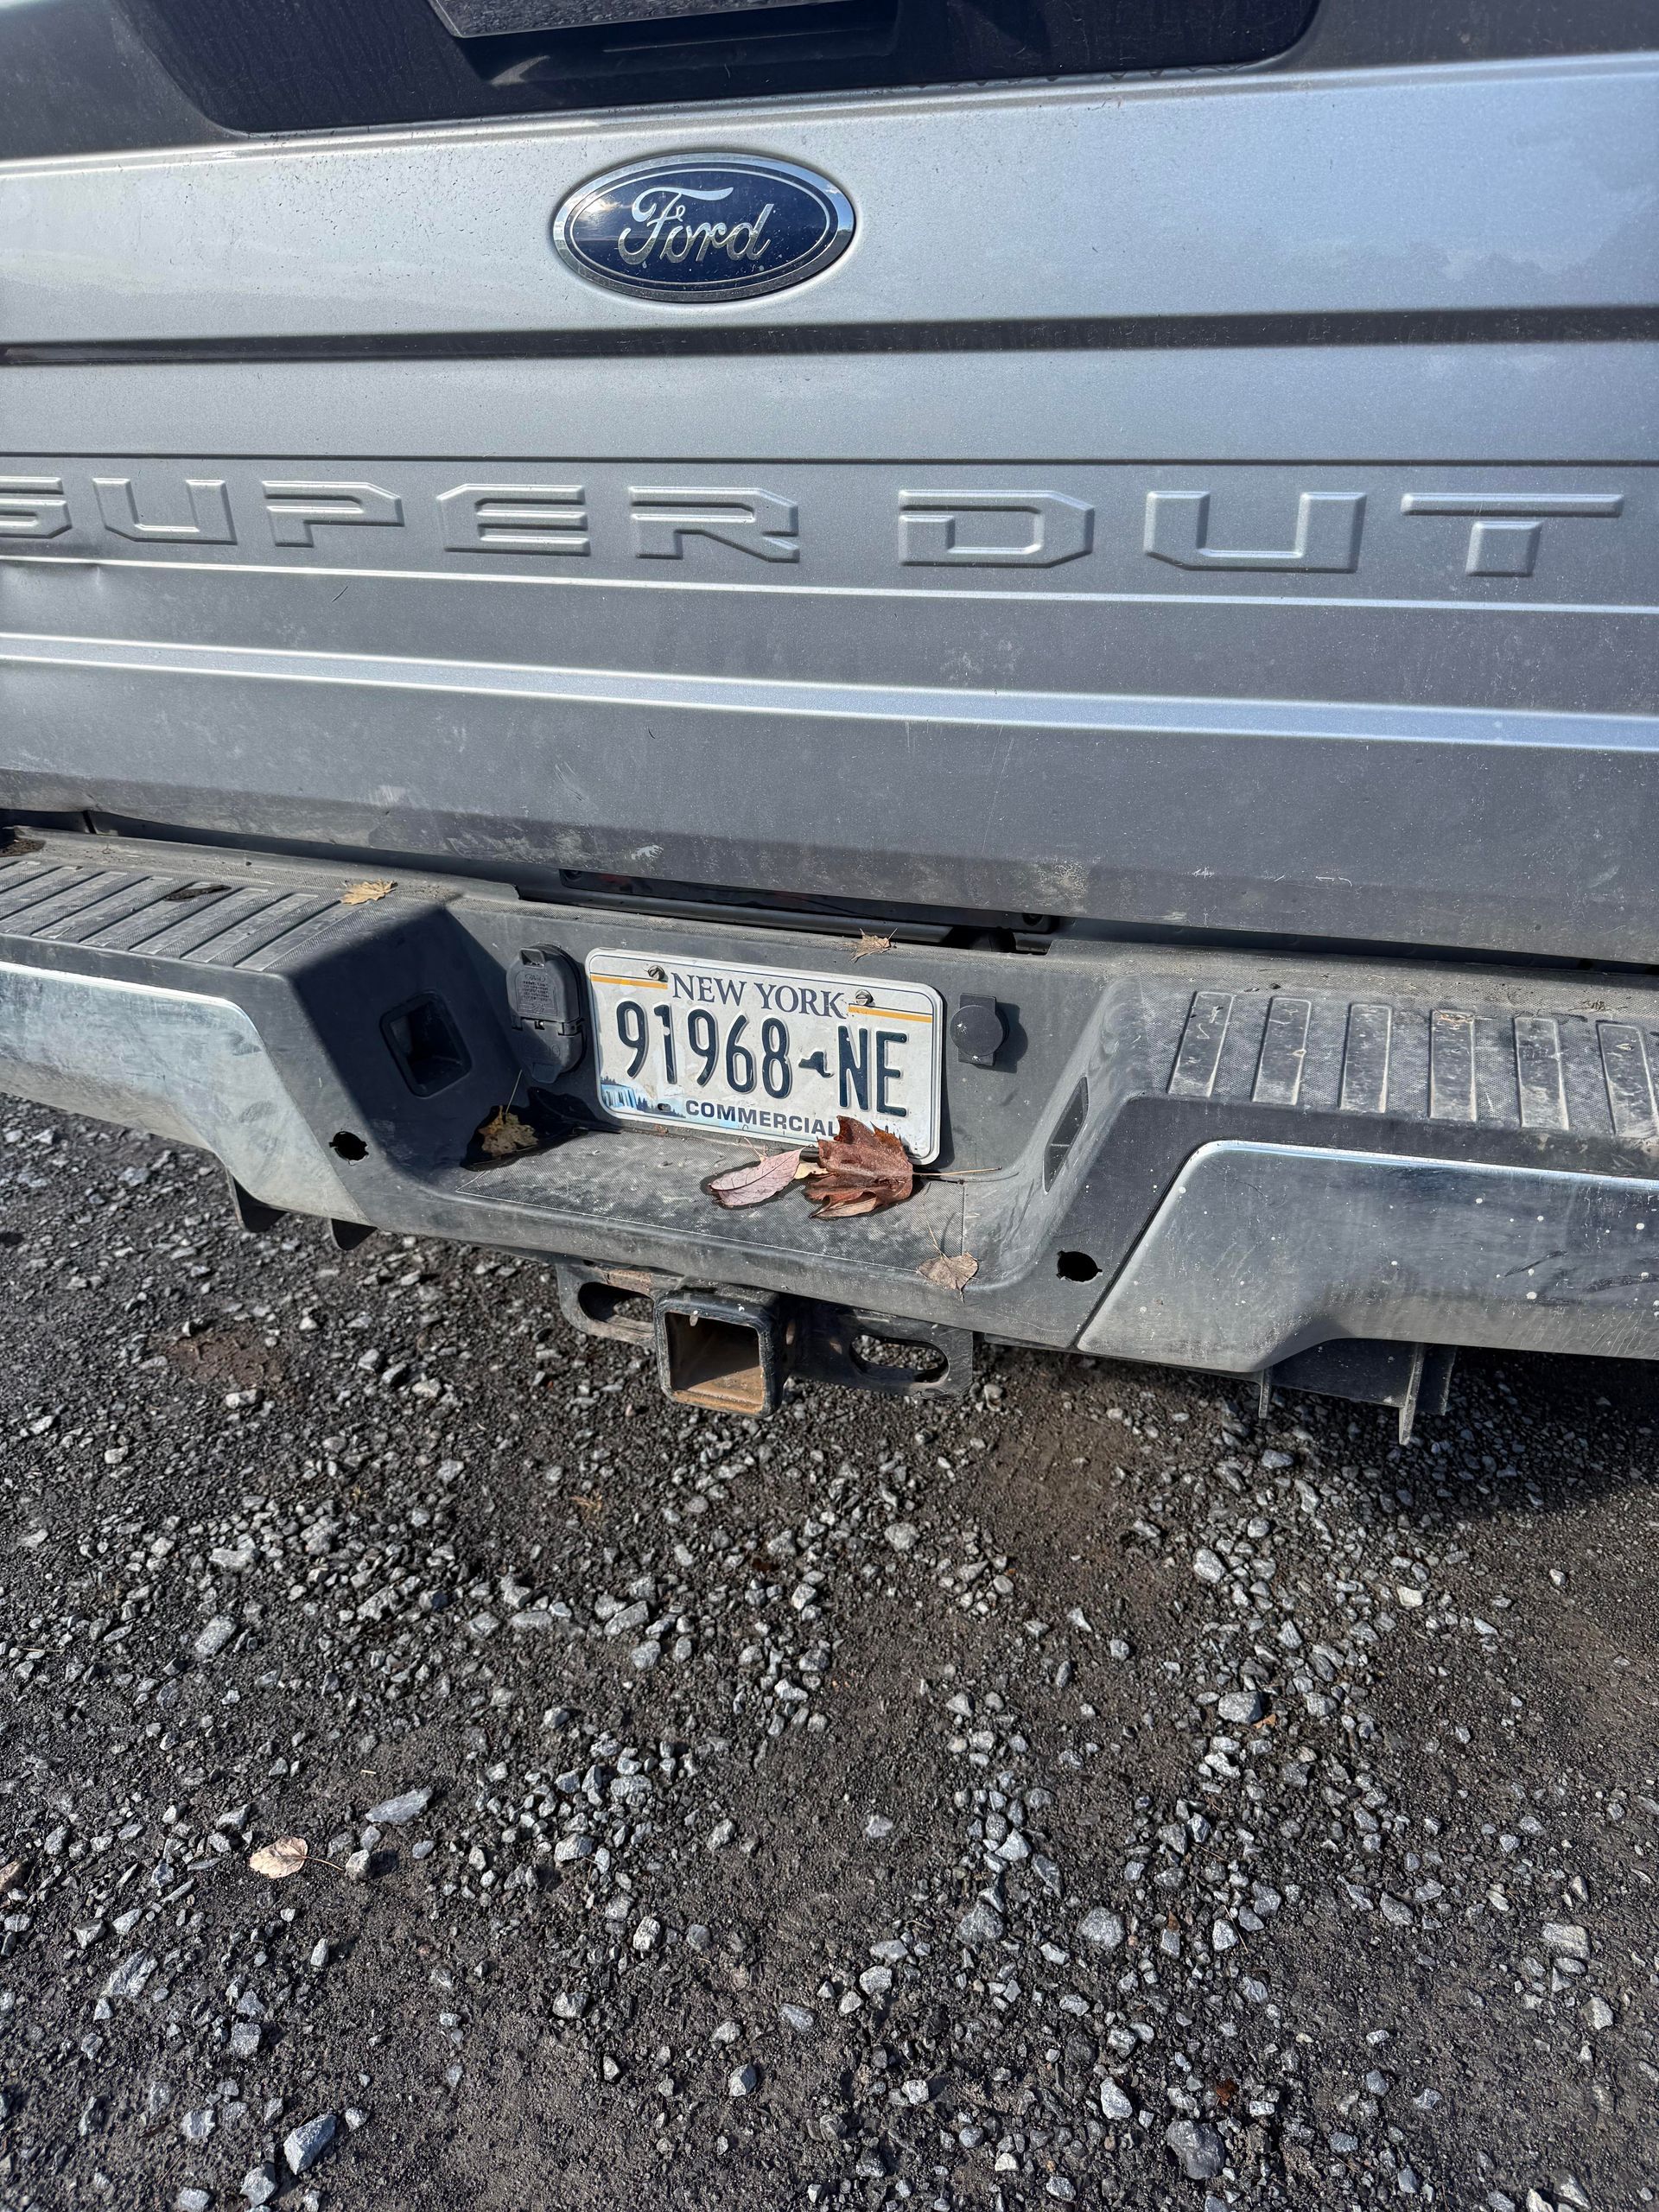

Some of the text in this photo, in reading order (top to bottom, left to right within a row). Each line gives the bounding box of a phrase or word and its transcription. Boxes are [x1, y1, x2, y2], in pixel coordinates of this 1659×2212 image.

[617, 187, 774, 264] Ford
[671, 973, 846, 1019] NEW YORK
[616, 1001, 907, 1116] 91968 NE
[685, 1099, 838, 1136] COMMERCIAL
